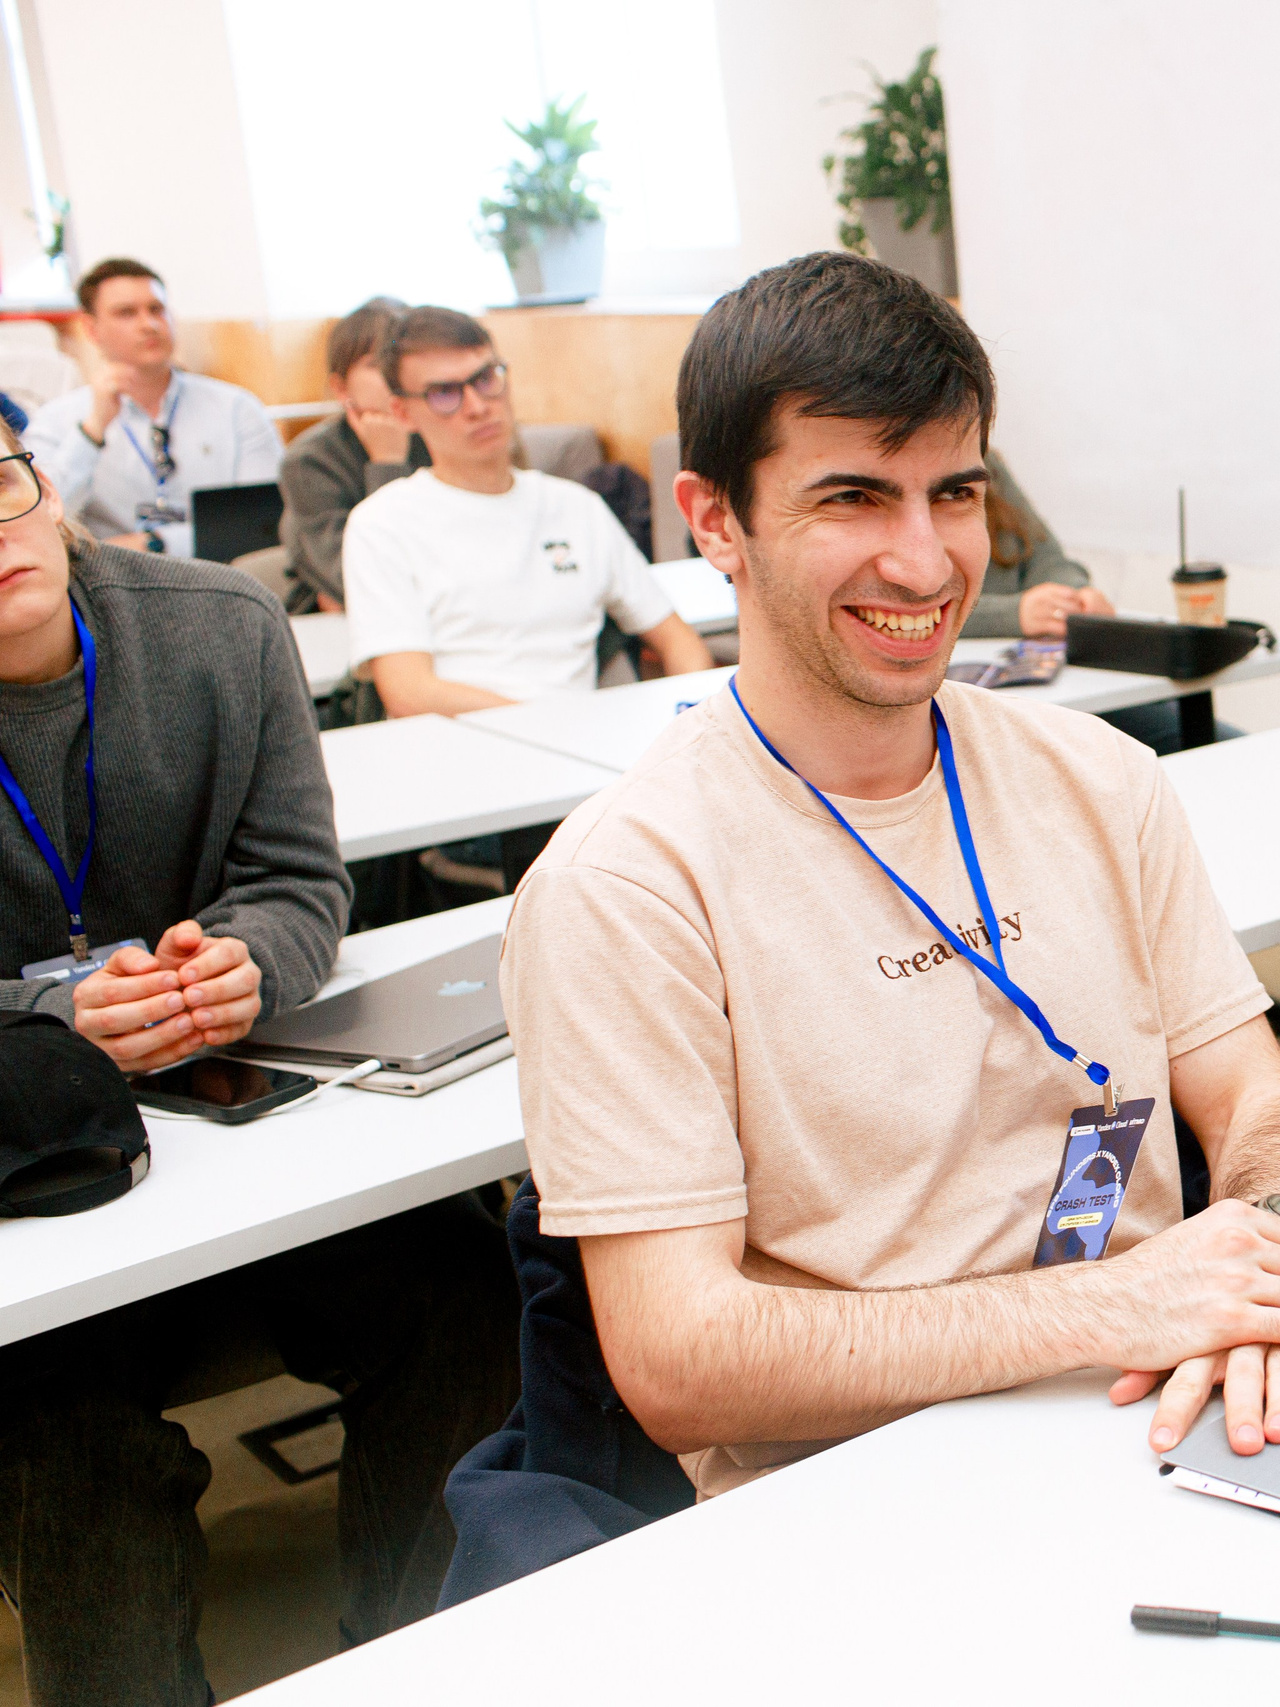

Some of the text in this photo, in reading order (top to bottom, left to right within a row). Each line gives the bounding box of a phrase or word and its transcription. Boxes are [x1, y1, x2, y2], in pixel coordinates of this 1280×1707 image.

[877, 912, 1023, 980] Creaiviy
[1055, 1193, 1115, 1211] CRASH TEST
[1101, 1150, 1121, 1173] YANDEX
[1113, 1170, 1122, 1208] CLOUD
